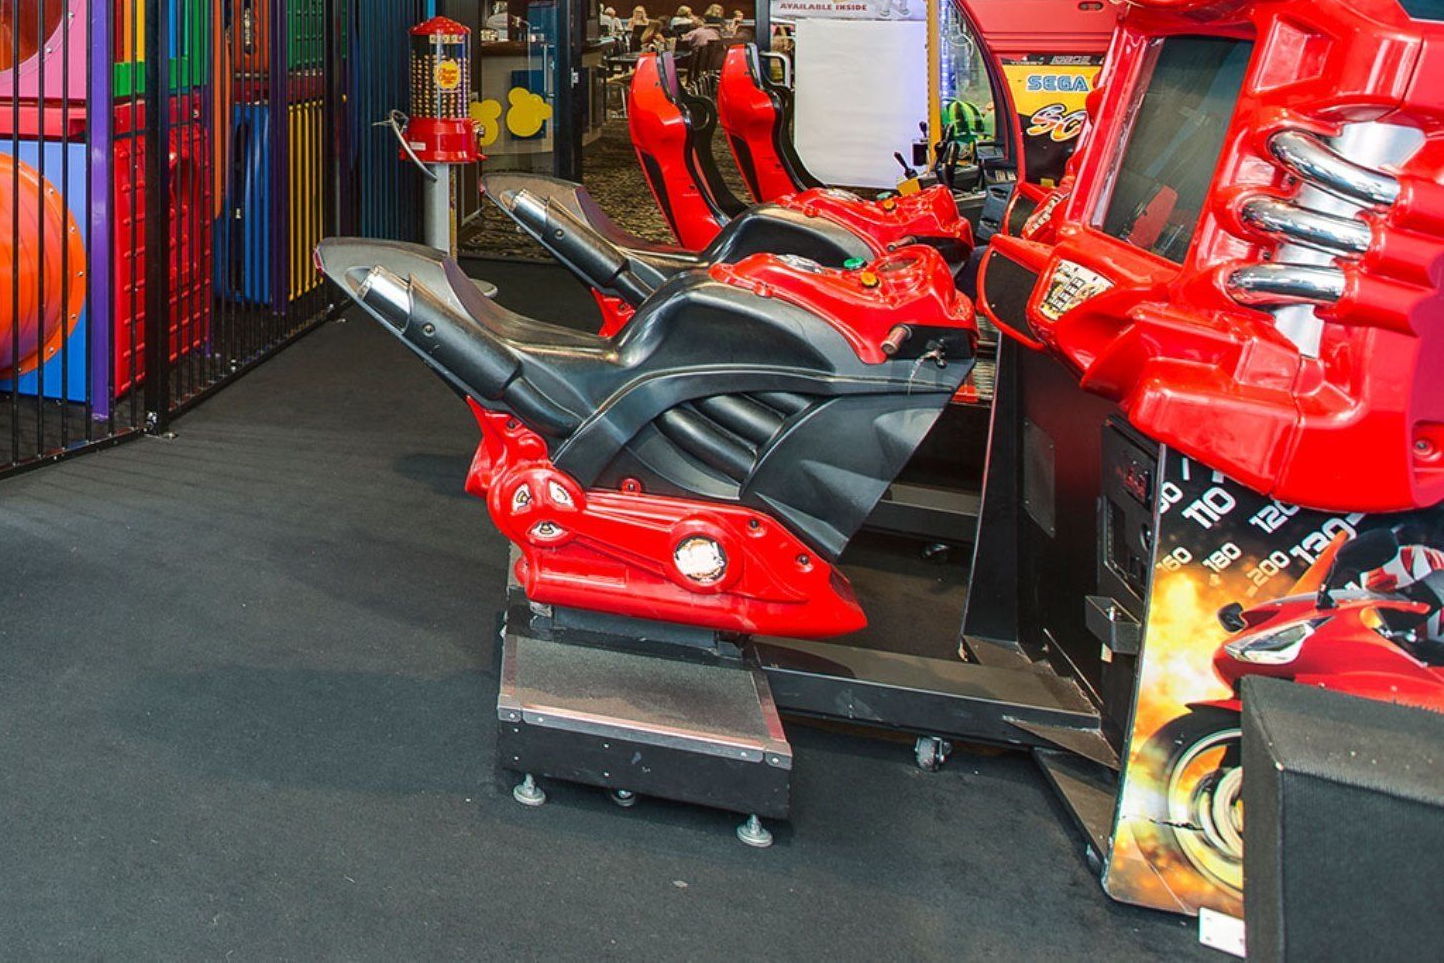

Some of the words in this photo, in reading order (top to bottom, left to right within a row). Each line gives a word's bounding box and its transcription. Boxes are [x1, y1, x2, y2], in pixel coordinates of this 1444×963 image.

[780, 3, 832, 11] AVAILABLE
[1027, 75, 1089, 92] SEGA
[1181, 487, 1236, 530] 110
[1202, 542, 1242, 573] 180
[1246, 550, 1291, 587] 200
